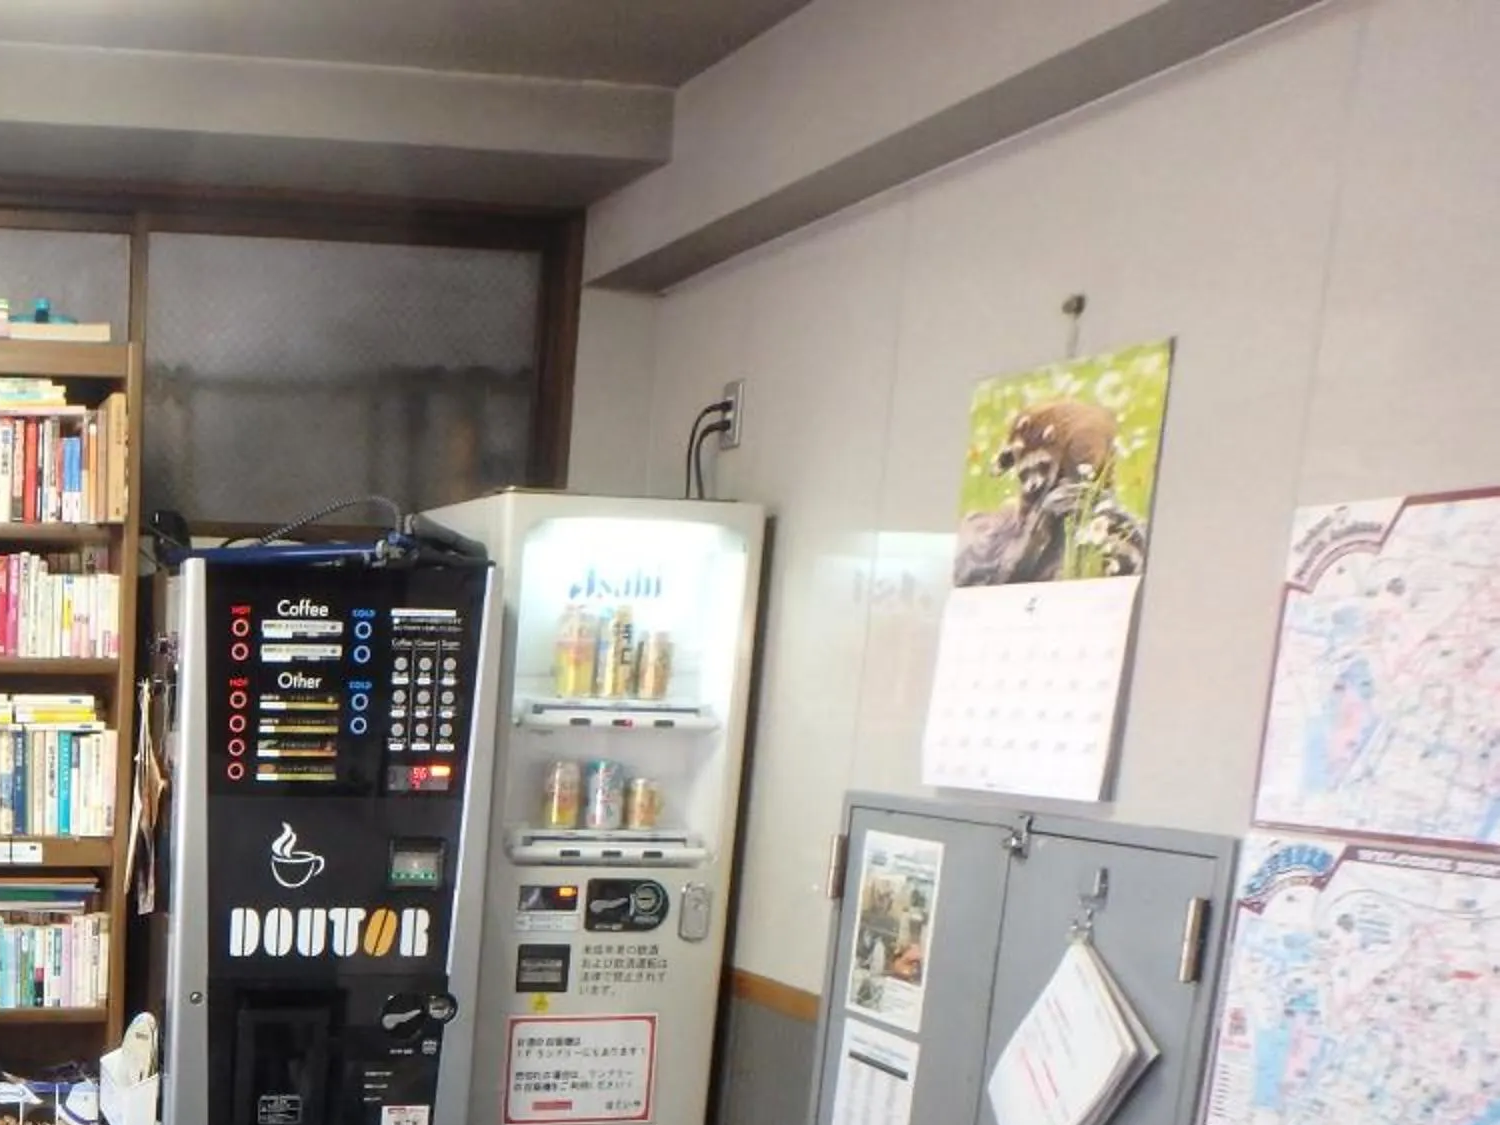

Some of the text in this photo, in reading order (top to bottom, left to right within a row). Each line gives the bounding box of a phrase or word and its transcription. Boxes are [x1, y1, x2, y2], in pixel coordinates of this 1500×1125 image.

[277, 600, 329, 618] Coffee
[278, 672, 323, 690] Other
[229, 907, 431, 957] DOUTOR
